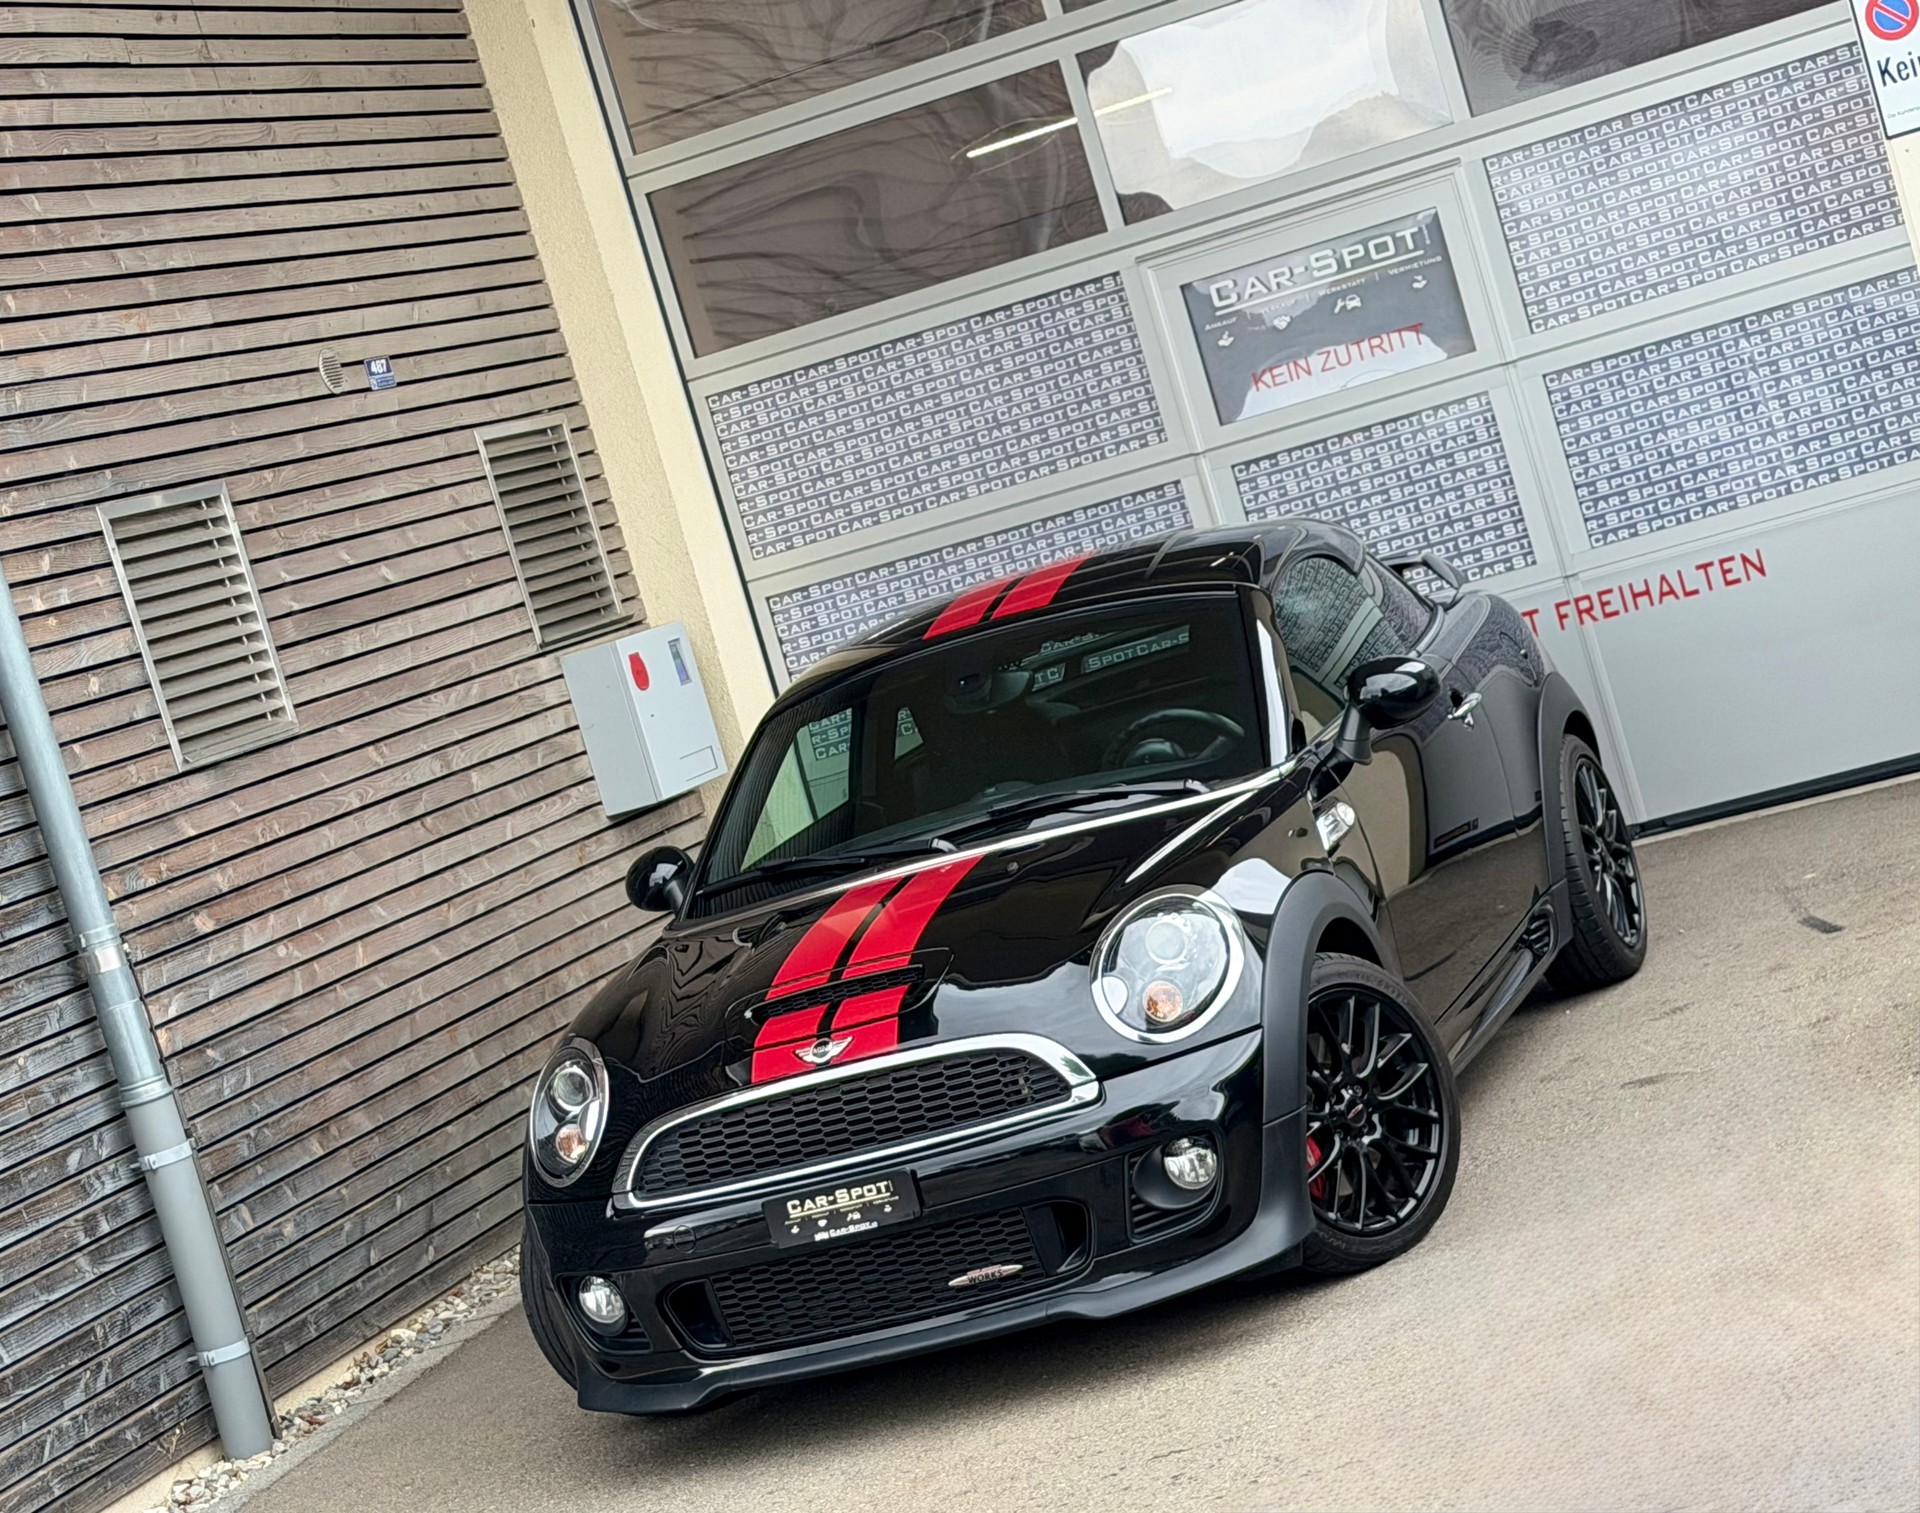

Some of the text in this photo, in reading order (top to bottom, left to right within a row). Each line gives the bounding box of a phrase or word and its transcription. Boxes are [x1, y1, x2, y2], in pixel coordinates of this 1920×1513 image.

[1209, 226, 1420, 308] CAR-SPOT
[1387, 255, 1443, 276] VERMIETUNG
[1250, 322, 1424, 393] KEIN ZUTRITT
[1348, 501, 1419, 531] R-SPOT
[1452, 537, 1531, 570] AR-SPOT
[1554, 548, 1767, 631] FREIHALTEN
[786, 1181, 888, 1215] CAR-SPOT
[967, 1270, 1004, 1286] WORKS
